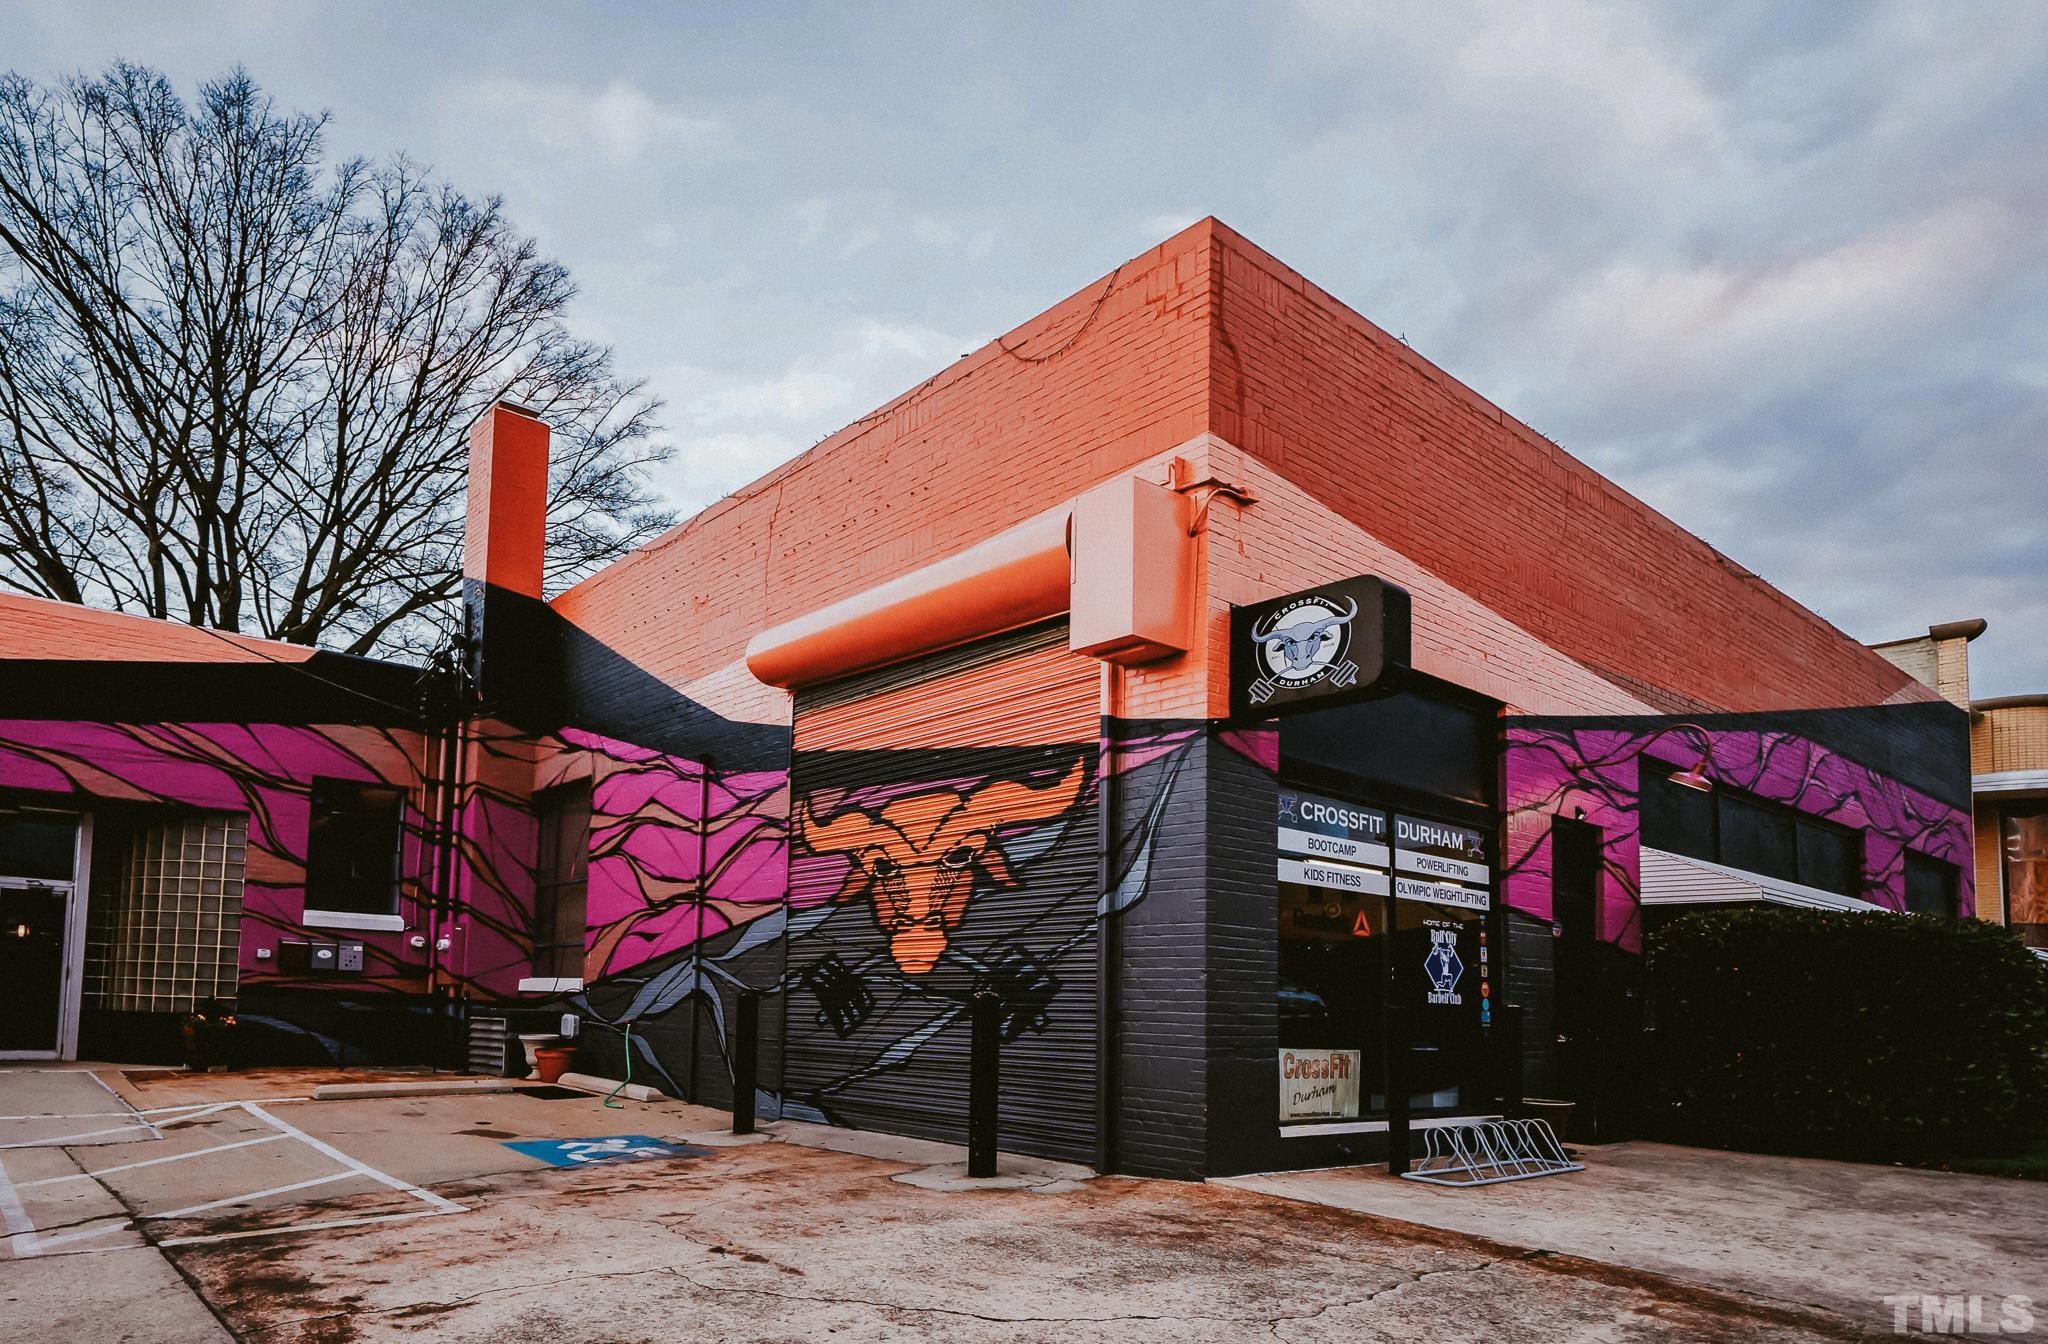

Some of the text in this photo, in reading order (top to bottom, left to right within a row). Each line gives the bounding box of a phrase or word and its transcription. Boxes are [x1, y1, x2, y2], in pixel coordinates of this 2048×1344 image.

[1274, 597, 1329, 620] CROSSFIT
[1279, 671, 1325, 687] DURHAM
[1300, 801, 1464, 851] CROSSFIT DURHAM
[1307, 837, 1357, 857] BOOTCAMP
[1303, 867, 1362, 887] KIDS FITNESS
[1416, 857, 1469, 877] POWERLIFTING
[1396, 881, 1487, 906] OLYMPIC WEIGHTLIFTING
[1422, 919, 1441, 927] HOME
[1452, 922, 1464, 930] THE
[1427, 991, 1462, 1005] Barbell Club
[1283, 1052, 1351, 1080] CrossFit
[1293, 1084, 1337, 1106] Durham
